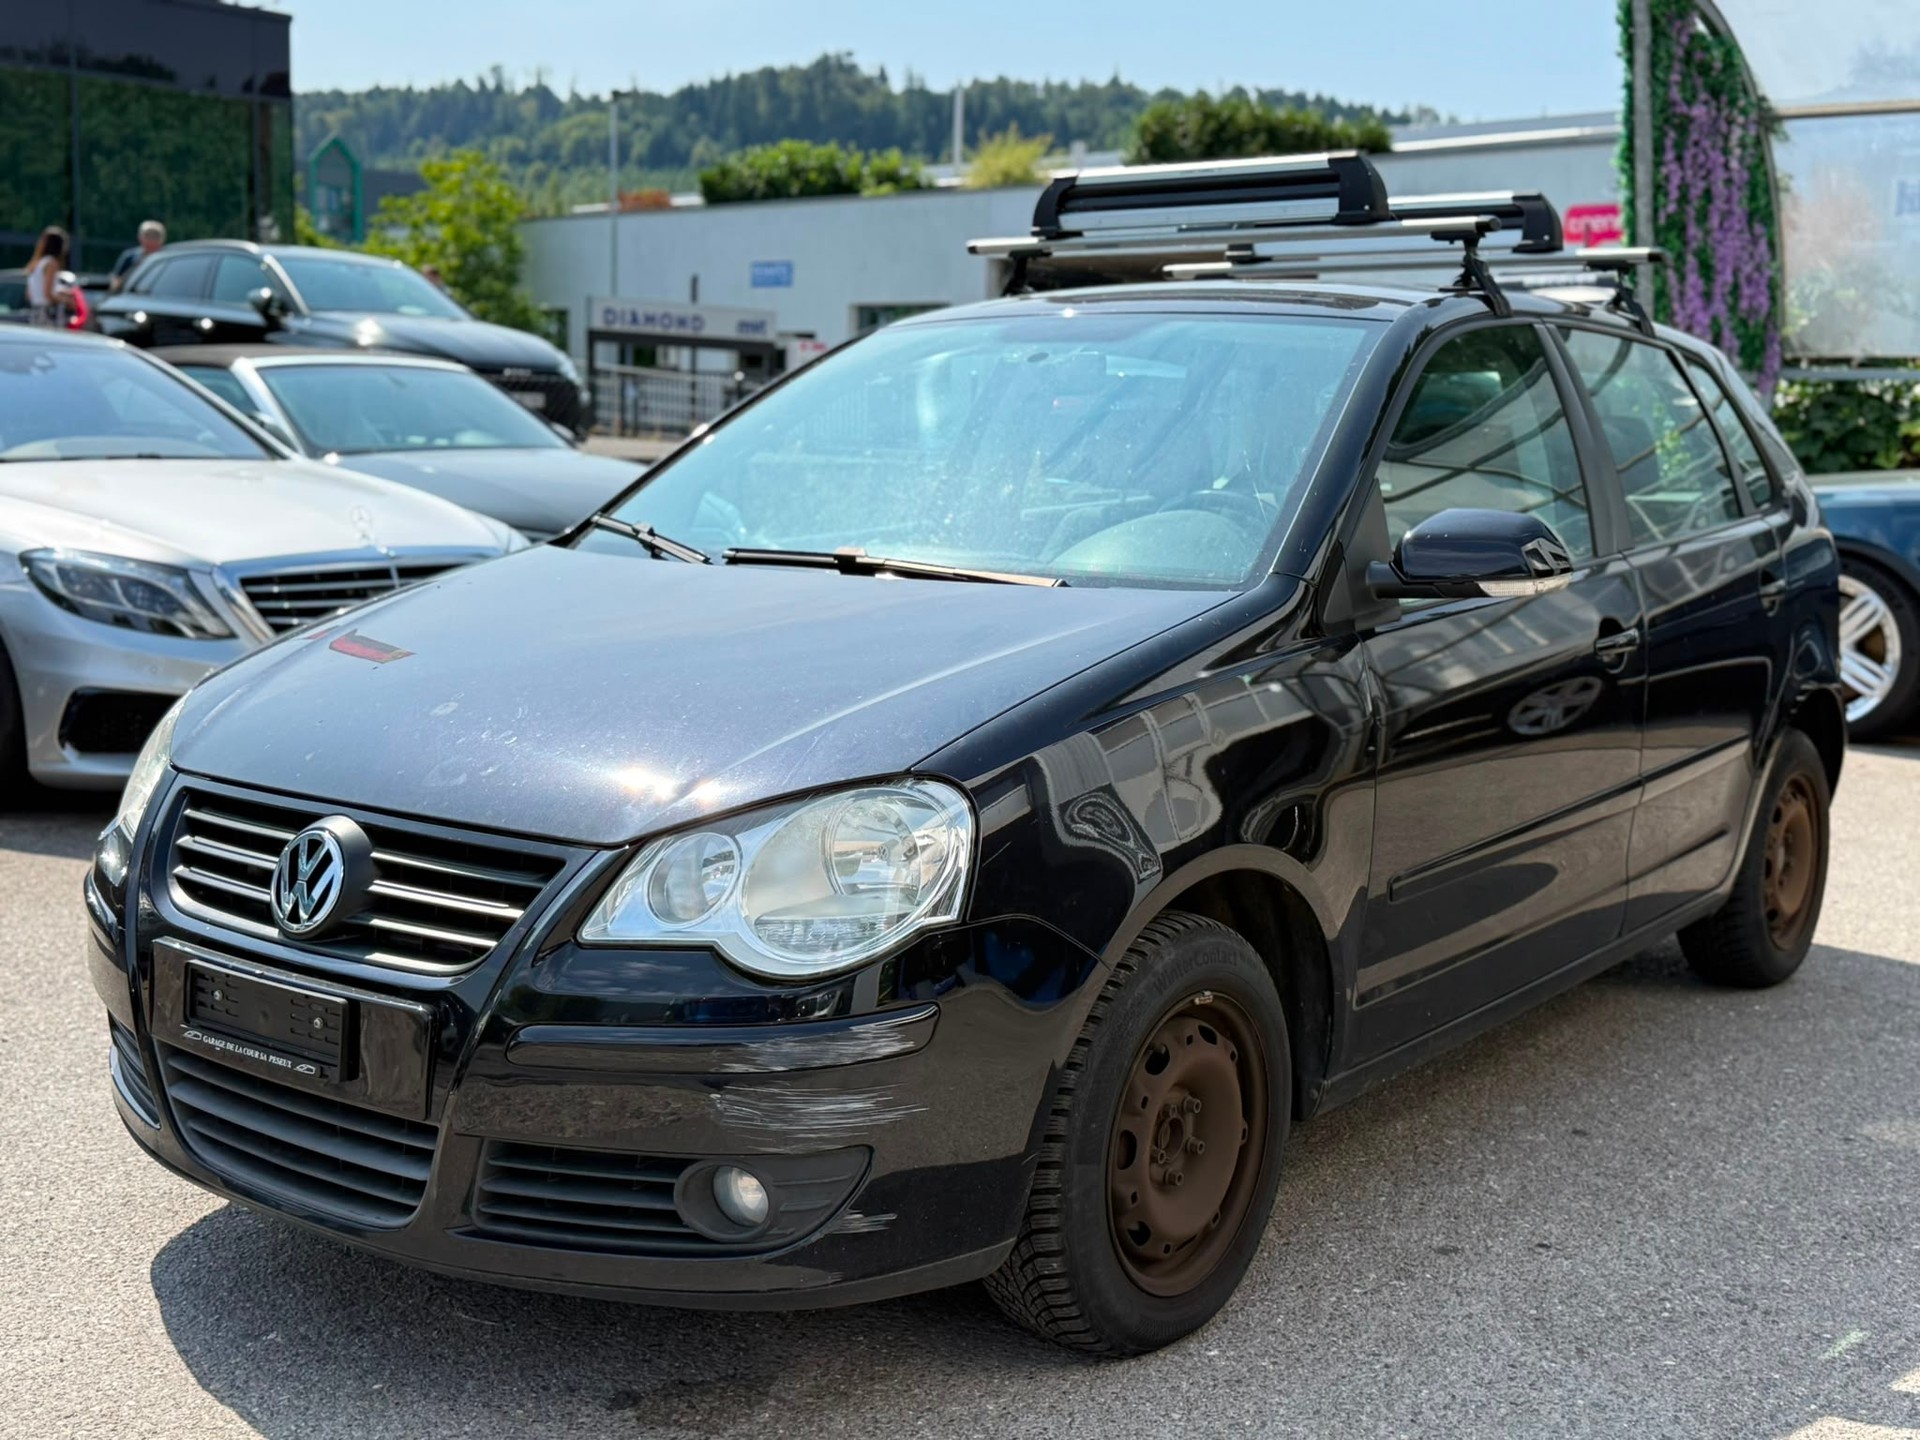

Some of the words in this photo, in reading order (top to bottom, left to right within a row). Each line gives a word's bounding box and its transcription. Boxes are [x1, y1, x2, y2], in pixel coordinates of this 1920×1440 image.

[603, 307, 705, 332] DIAMOND
[1153, 946, 1238, 994] WinterContact
[202, 1035, 225, 1049] GARAGE
[226, 1042, 235, 1051] DE
[235, 1045, 243, 1054] LA
[243, 1047, 259, 1059] COUR
[268, 1055, 293, 1069] PESEUX
